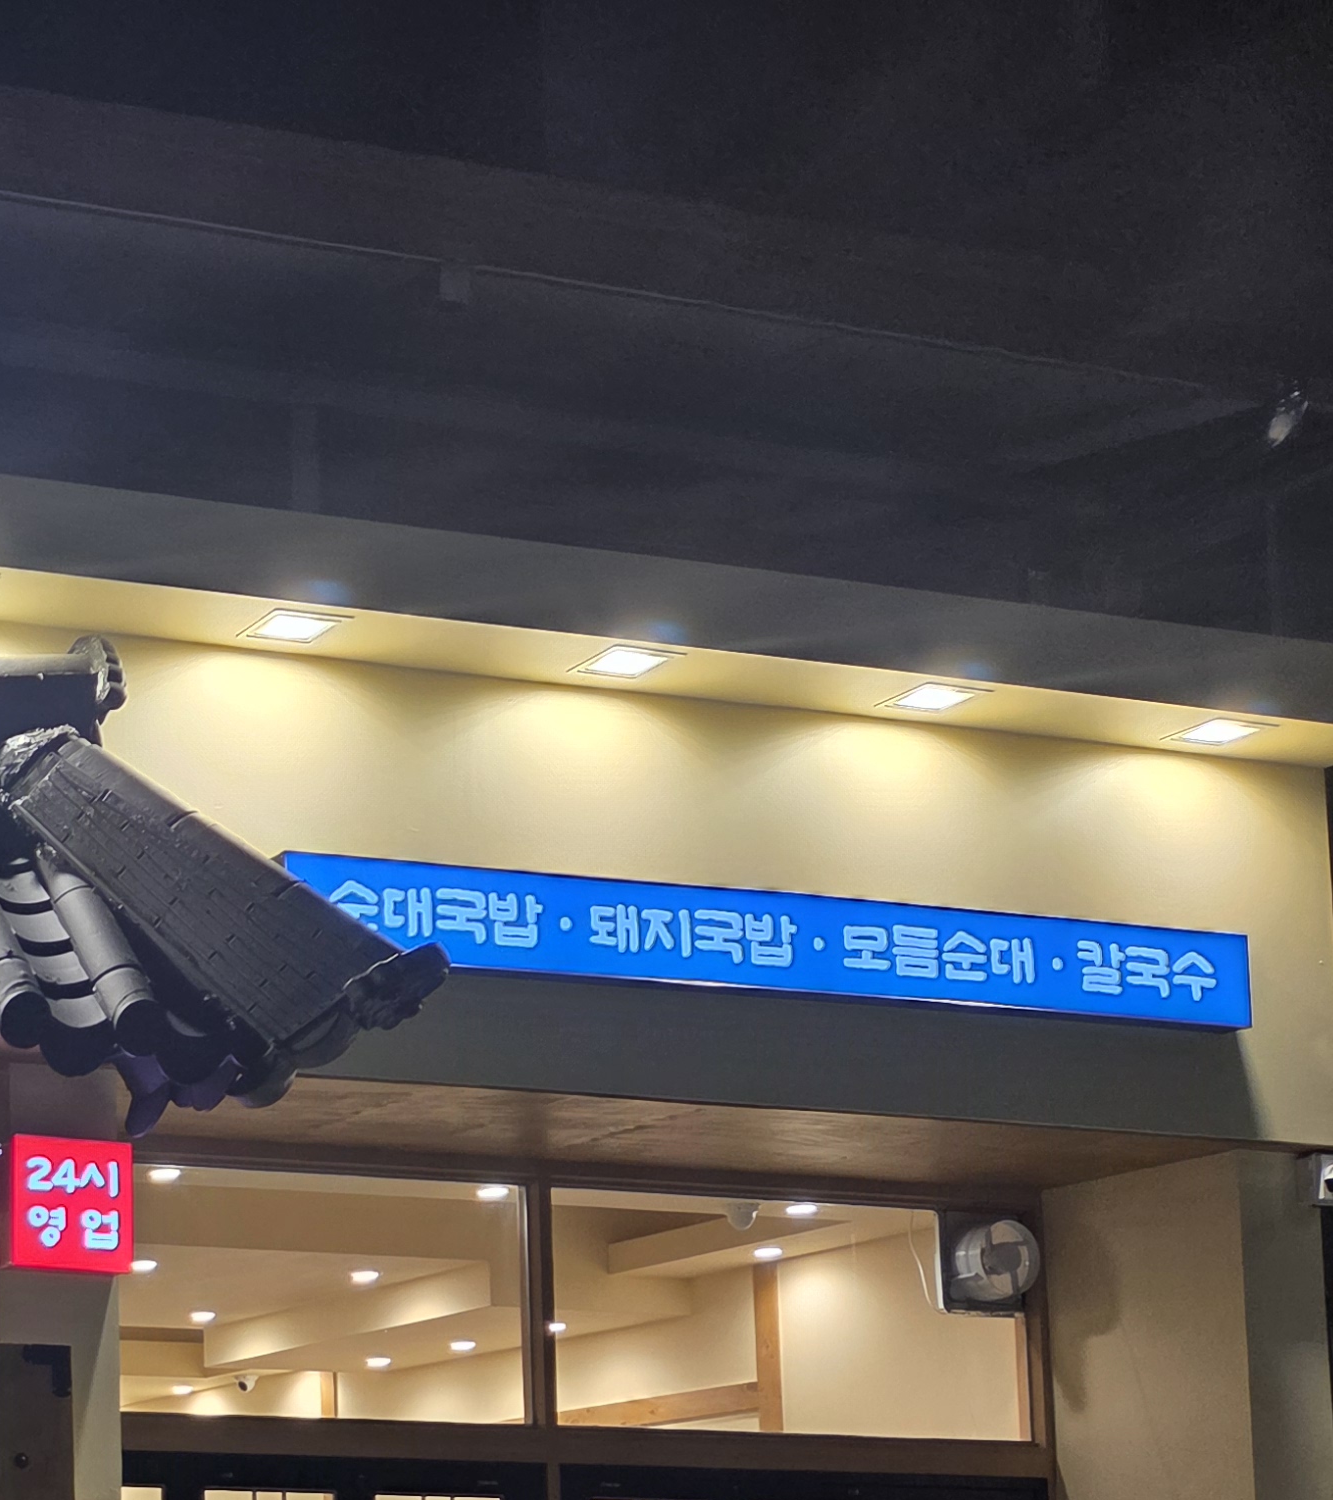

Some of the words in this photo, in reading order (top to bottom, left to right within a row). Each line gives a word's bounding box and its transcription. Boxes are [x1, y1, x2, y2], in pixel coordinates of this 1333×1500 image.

[589, 903, 797, 970] 돼지국밥
[843, 924, 1036, 984] 모듬순대
[1077, 938, 1218, 1002] 칼국수
[26, 1156, 119, 1198] 24시
